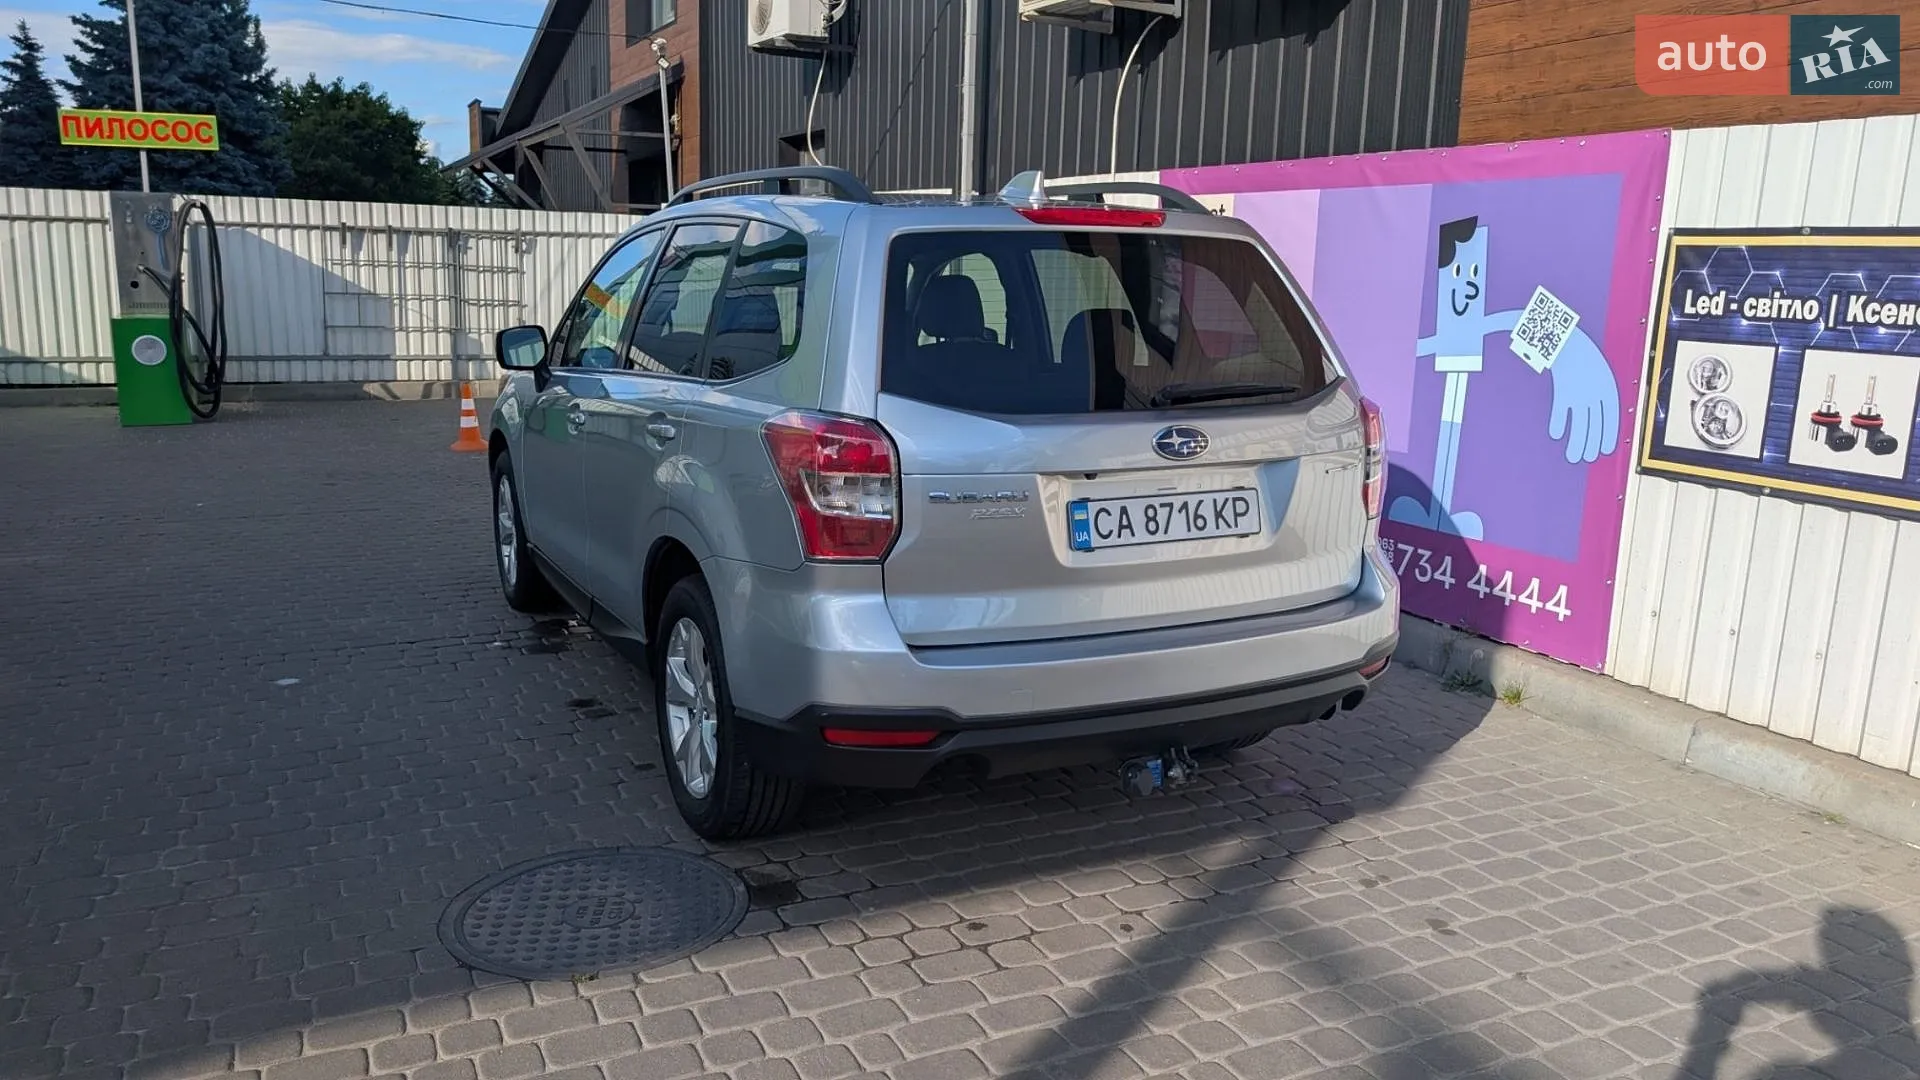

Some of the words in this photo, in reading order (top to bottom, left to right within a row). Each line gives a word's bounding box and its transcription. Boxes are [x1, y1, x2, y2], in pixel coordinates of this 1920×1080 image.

[62, 115, 213, 144] ПИЛОСОС
[1684, 289, 1726, 316] Led
[1743, 291, 1819, 320] світло
[1144, 500, 1207, 536] 8716
[1075, 531, 1090, 543] UA
[1396, 542, 1456, 590] 734
[1466, 563, 1572, 622] 4444
